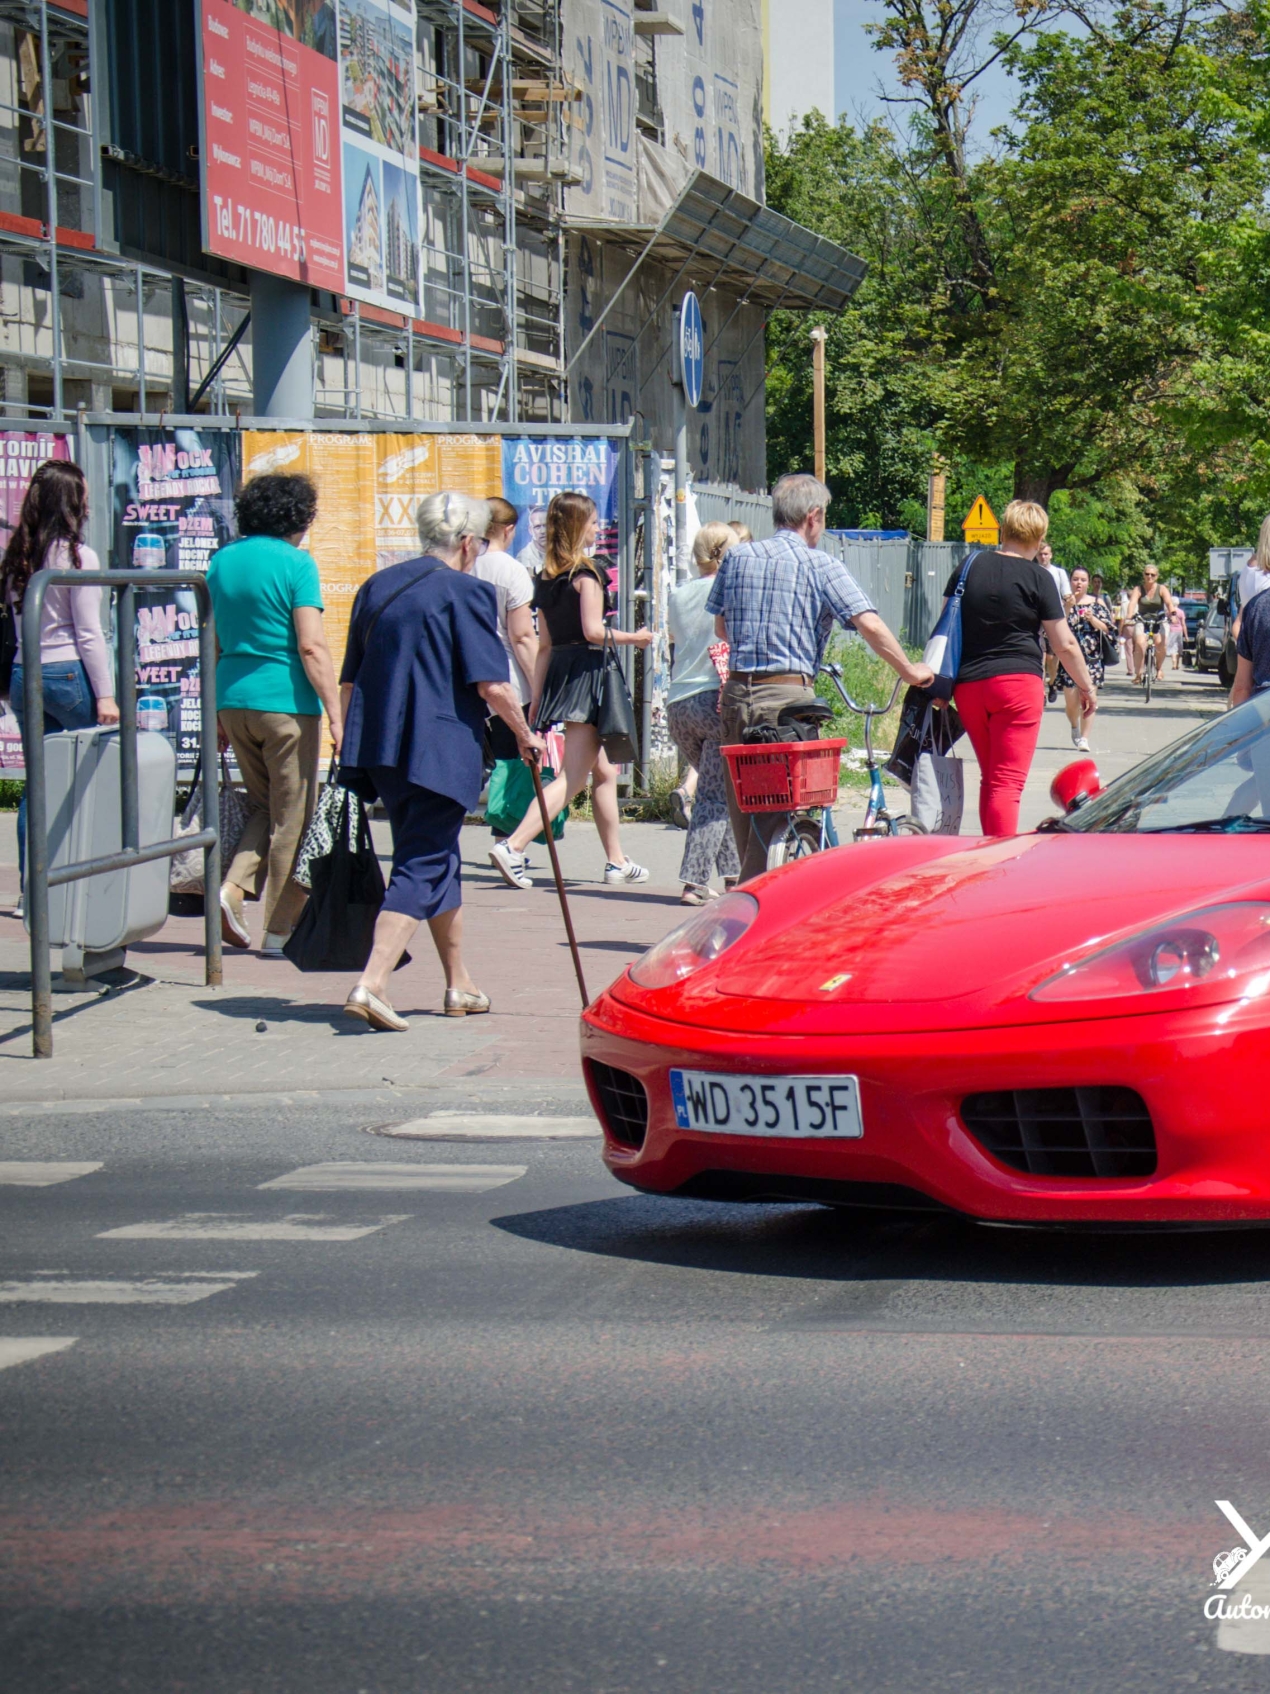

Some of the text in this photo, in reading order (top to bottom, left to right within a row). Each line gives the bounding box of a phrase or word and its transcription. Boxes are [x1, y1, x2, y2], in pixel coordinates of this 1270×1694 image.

[605, 60, 632, 153] MD
[314, 116, 329, 161] MD
[214, 195, 236, 240] Tel.
[237, 205, 251, 245] 71
[254, 212, 276, 253] 780
[277, 220, 291, 258] 44
[293, 226, 307, 263] 55
[309, 434, 373, 446] PROGRAM:
[437, 435, 500, 446] PROGRAM:
[513, 444, 607, 463] AVISHAI
[514, 463, 607, 485] COHEN
[123, 504, 181, 521] SWEET
[178, 537, 220, 549] JELONEK
[180, 710, 201, 721] NOC
[180, 721, 201, 732] KOC
[677, 1105, 687, 1118] PL
[687, 1078, 850, 1132] WD 3515F
